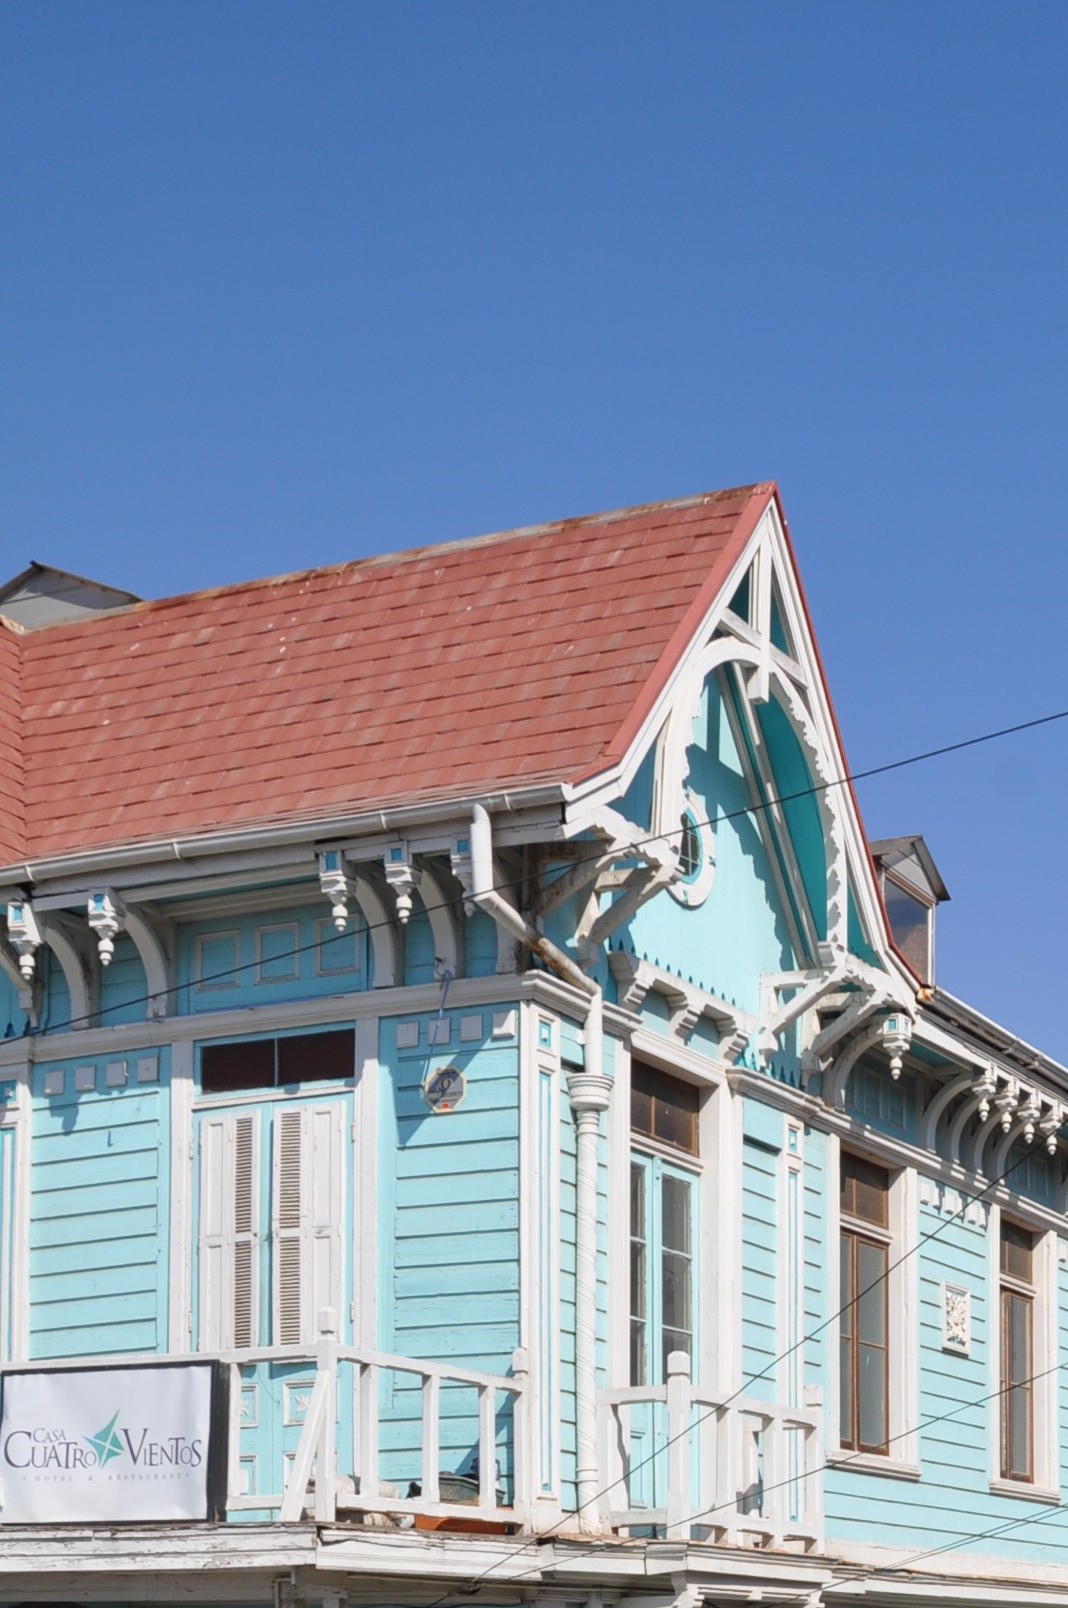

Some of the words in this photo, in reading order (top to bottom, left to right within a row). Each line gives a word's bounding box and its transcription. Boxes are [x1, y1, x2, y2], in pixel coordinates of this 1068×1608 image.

[3, 1430, 97, 1469] CUATRO
[120, 1427, 202, 1467] VIENTOS
[33, 1427, 66, 1443] CASA
